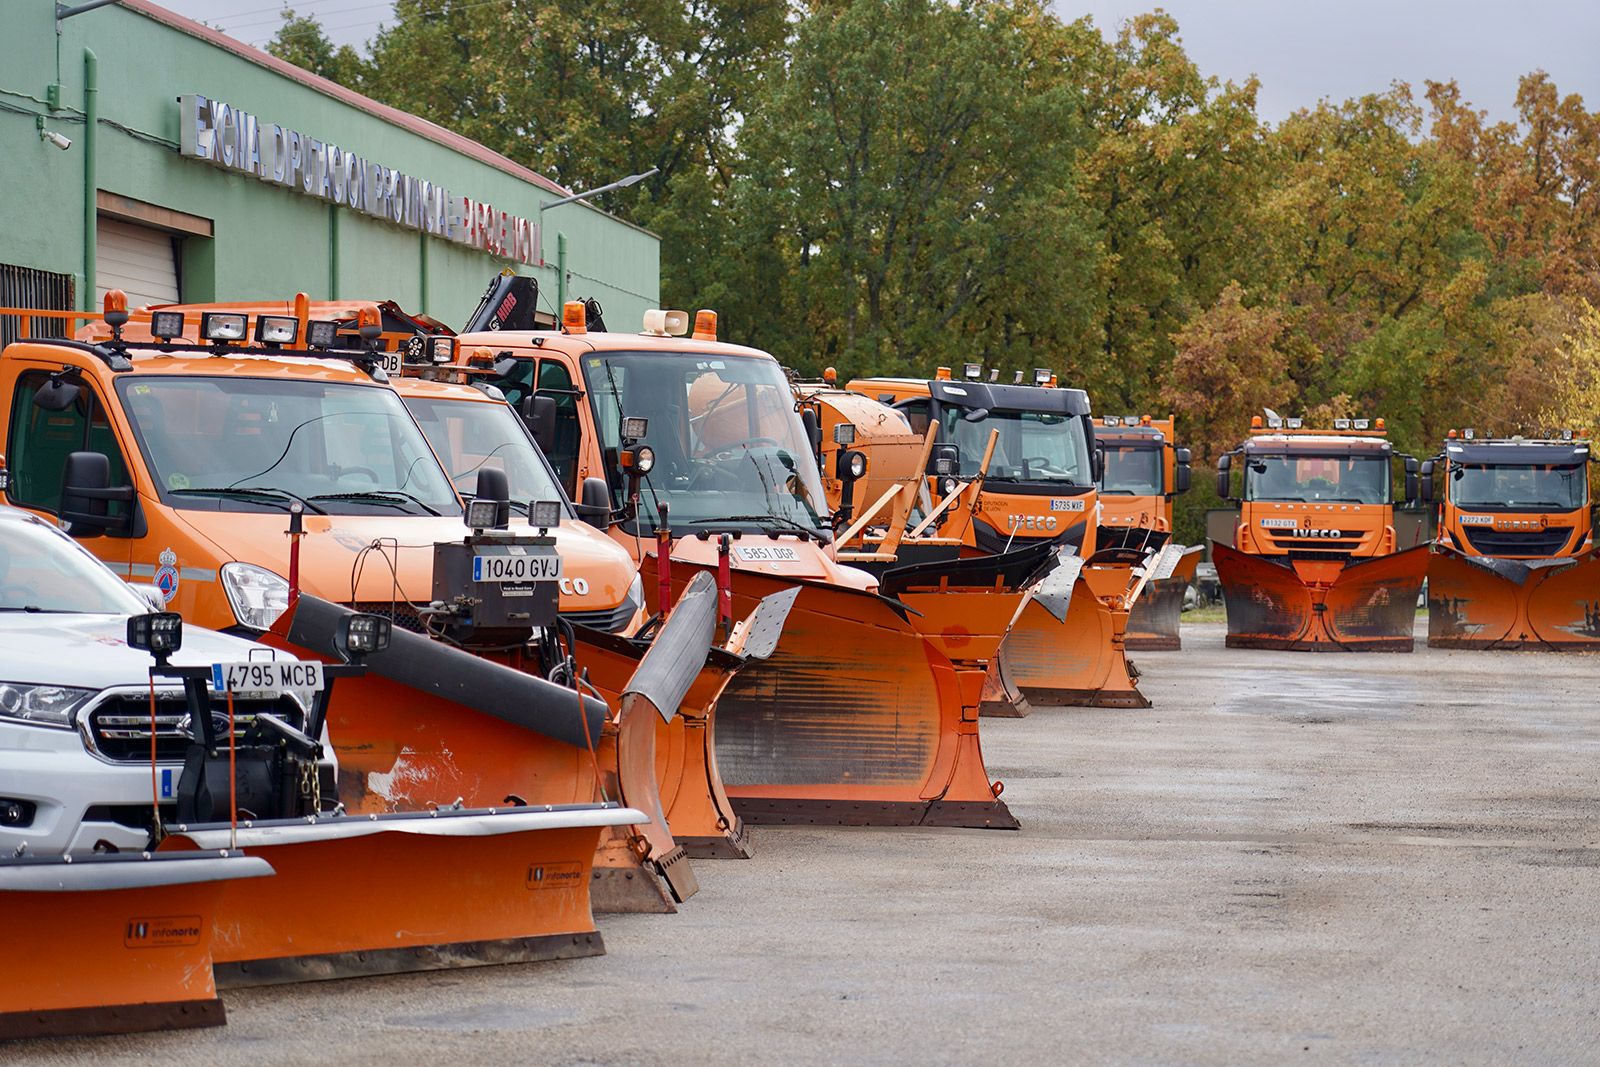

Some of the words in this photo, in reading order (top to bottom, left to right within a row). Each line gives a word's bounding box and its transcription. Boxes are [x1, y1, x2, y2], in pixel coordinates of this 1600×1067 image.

[496, 291, 518, 323] HIAB
[381, 355, 398, 371] DB
[1055, 500, 1071, 510] 5735
[1008, 514, 1057, 530] IVECO
[1463, 515, 1479, 523] 2272
[1293, 529, 1341, 538] IVECO
[743, 547, 773, 560] 5851
[773, 547, 794, 560] DGP
[487, 559, 525, 579] 1040
[530, 559, 560, 578] GVJ
[559, 577, 590, 596] CO
[227, 665, 274, 688] 4795
[280, 664, 317, 687] MCB
[545, 871, 581, 881] infonorte
[152, 926, 200, 938] infonorte
